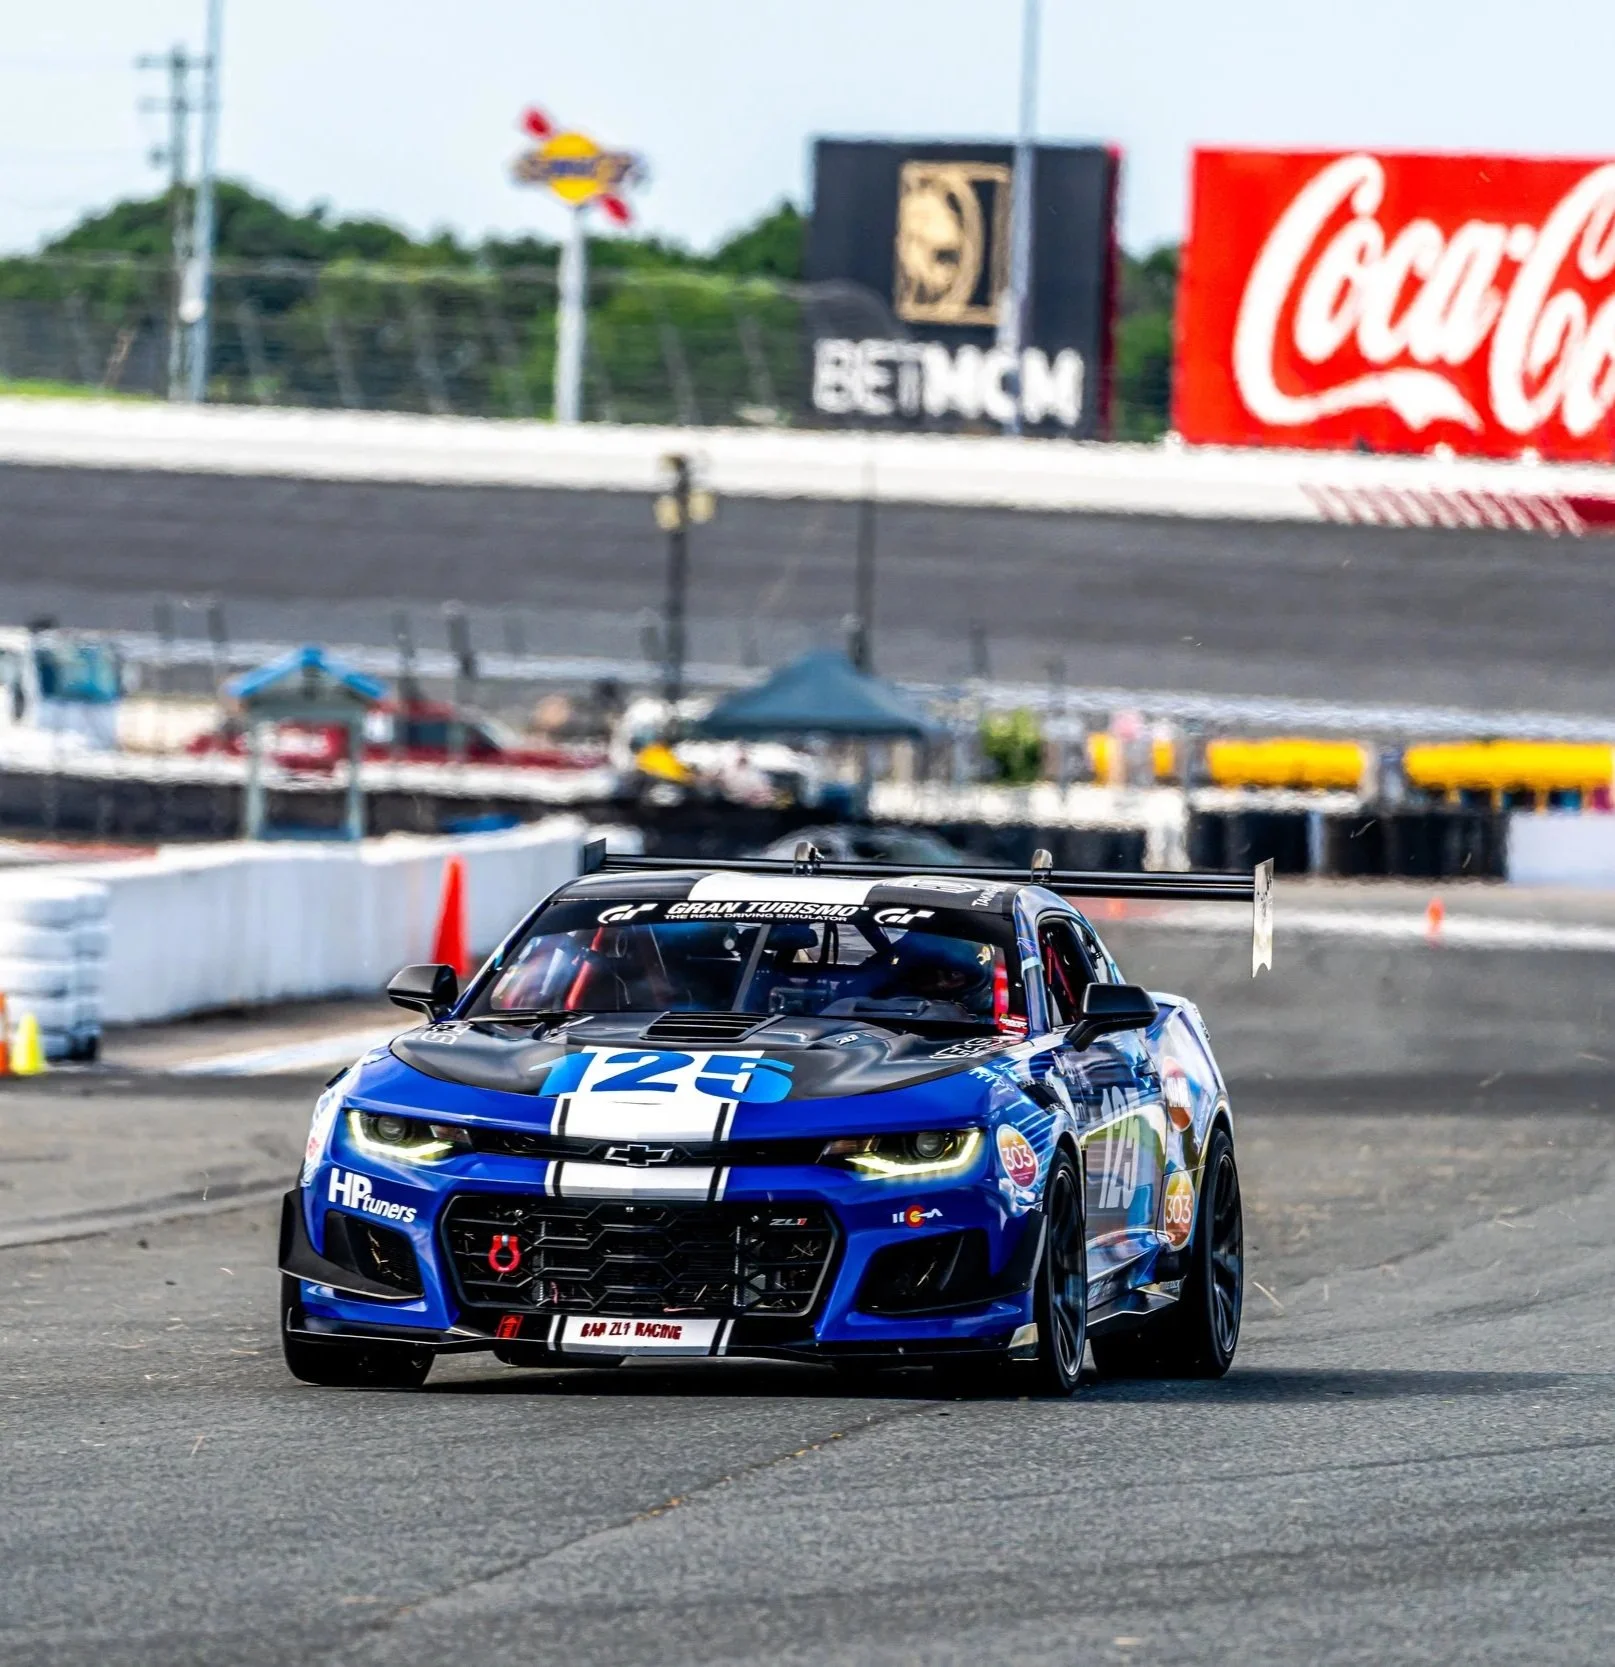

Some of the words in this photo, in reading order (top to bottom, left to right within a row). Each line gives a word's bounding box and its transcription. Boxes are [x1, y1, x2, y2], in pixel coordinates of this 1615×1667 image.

[667, 902, 742, 914] GRAN
[745, 902, 860, 917] TURISMO
[776, 913, 847, 922] SIMULATOR
[528, 1051, 795, 1104] 125
[1002, 1144, 1034, 1171] 303
[1098, 1085, 1141, 1210] 125
[1166, 1193, 1192, 1224] 303
[769, 1217, 808, 1226] ZL1
[609, 1322, 631, 1336] ZL1
[634, 1322, 682, 1340] RACING
